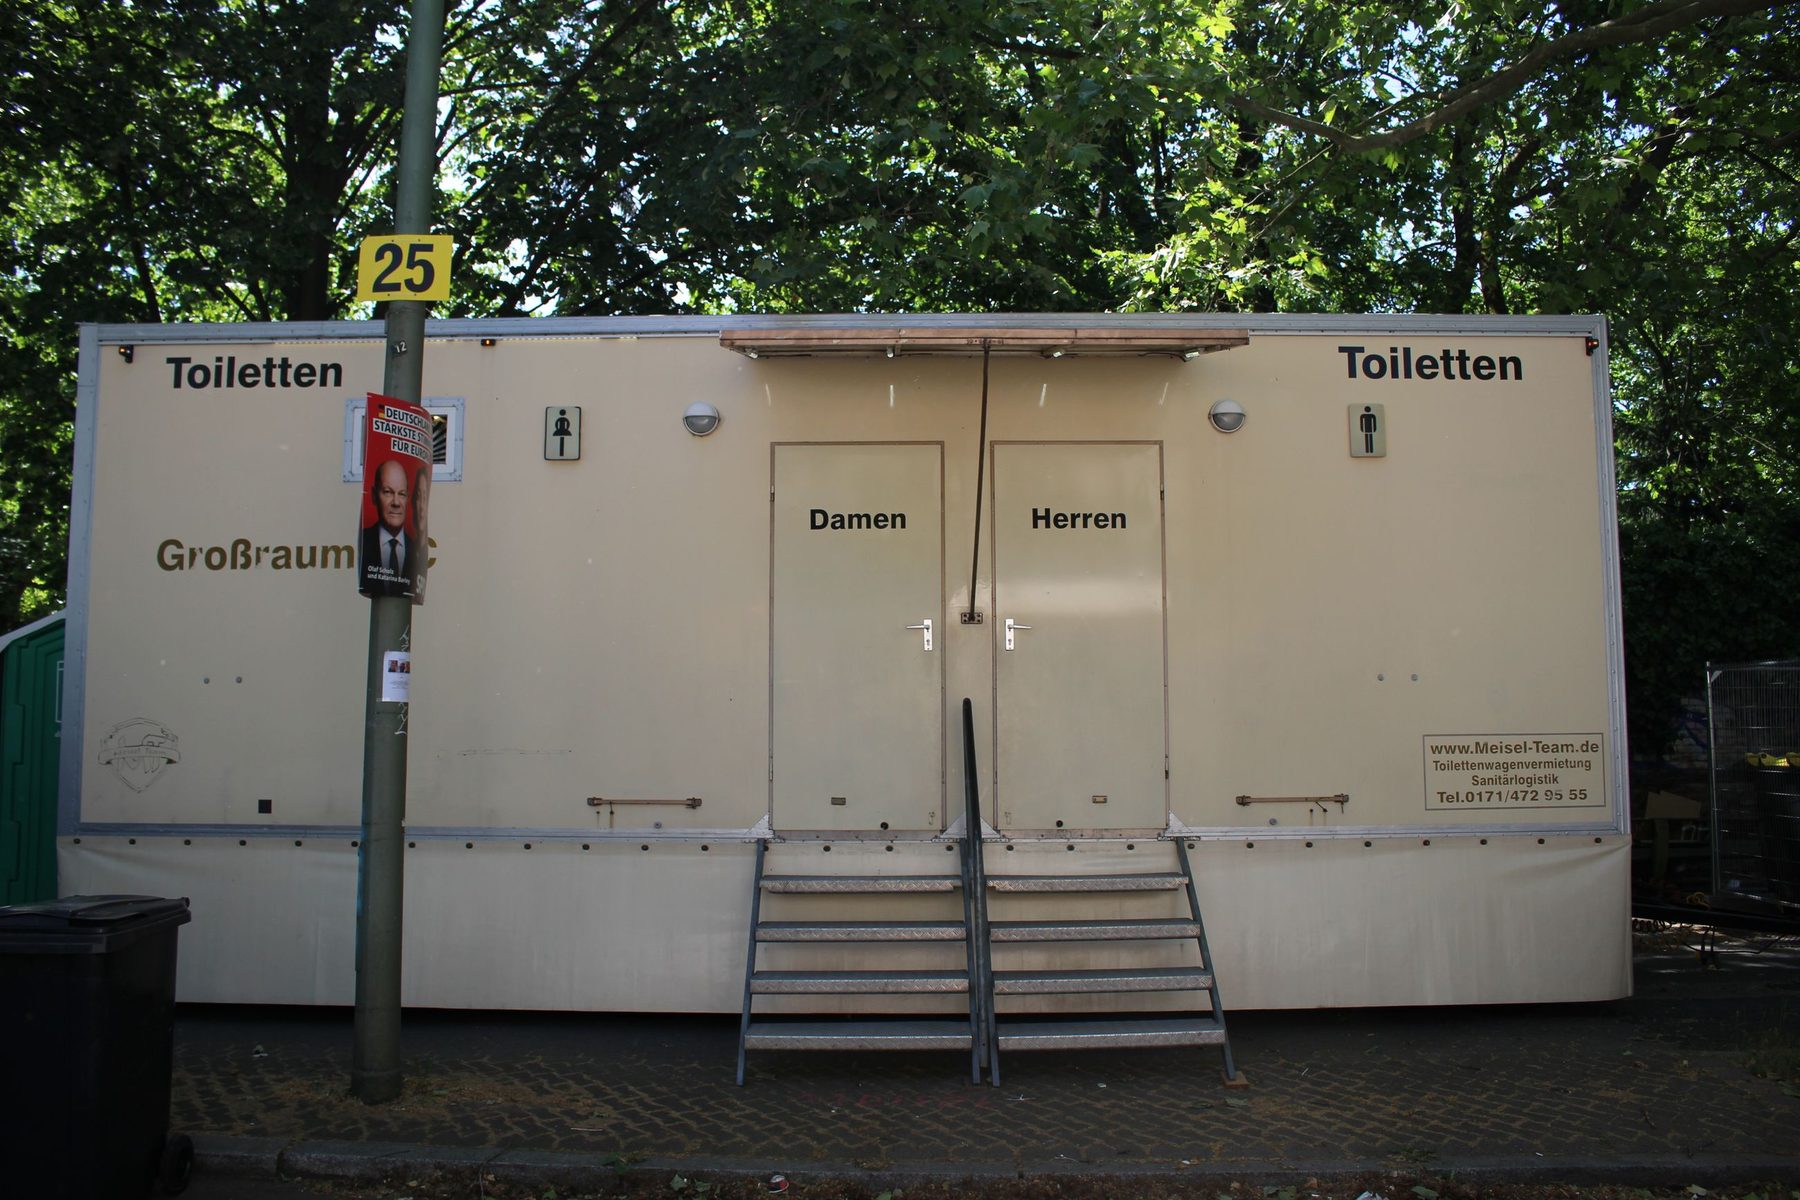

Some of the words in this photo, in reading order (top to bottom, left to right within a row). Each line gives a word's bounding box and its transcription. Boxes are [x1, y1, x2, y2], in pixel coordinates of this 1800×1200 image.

[371, 243, 435, 293] 25
[166, 356, 343, 389] Toiletten
[1338, 346, 1523, 381] Toiletten
[809, 508, 907, 530] Damen
[1031, 508, 1127, 529] Herren
[157, 538, 355, 571] Großraum
[1430, 740, 1599, 755] www.Meisel-Team.de
[1432, 758, 1592, 773] Toilettenwagenvermietung
[1471, 774, 1559, 788] Sanitärlogistik
[1436, 790, 1539, 804] Tel.0171/472
[1544, 789, 1564, 801] 95
[1568, 788, 1588, 801] 55
